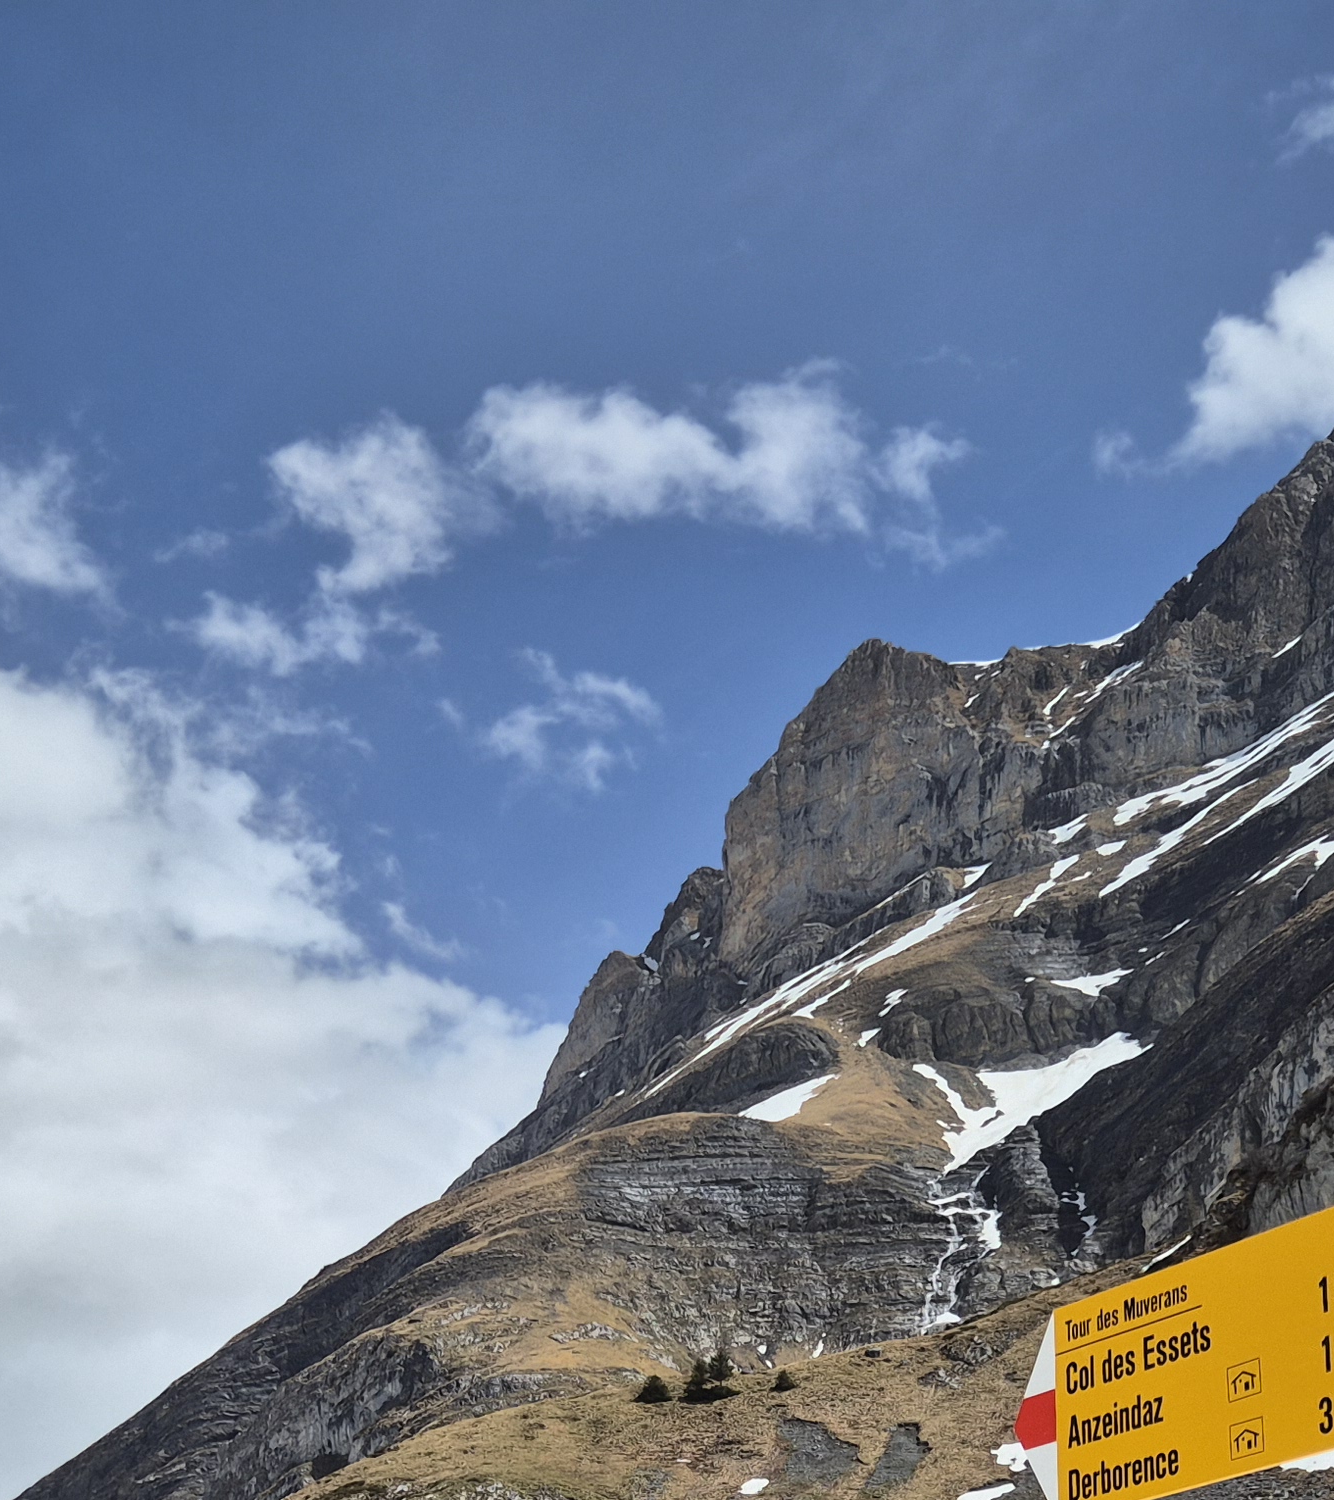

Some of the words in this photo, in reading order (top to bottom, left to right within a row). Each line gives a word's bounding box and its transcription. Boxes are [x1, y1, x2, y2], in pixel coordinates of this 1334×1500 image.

[1065, 1318, 1091, 1342] Tour
[1097, 1309, 1118, 1331] des
[1123, 1284, 1188, 1322] Muverans
[1318, 1276, 1329, 1313] 1
[1066, 1355, 1094, 1394] Col
[1102, 1349, 1136, 1384] des
[1143, 1321, 1211, 1371] Essets
[1321, 1335, 1331, 1373] 1
[1068, 1394, 1164, 1449] Anzeindaz
[1319, 1396, 1333, 1434] 3
